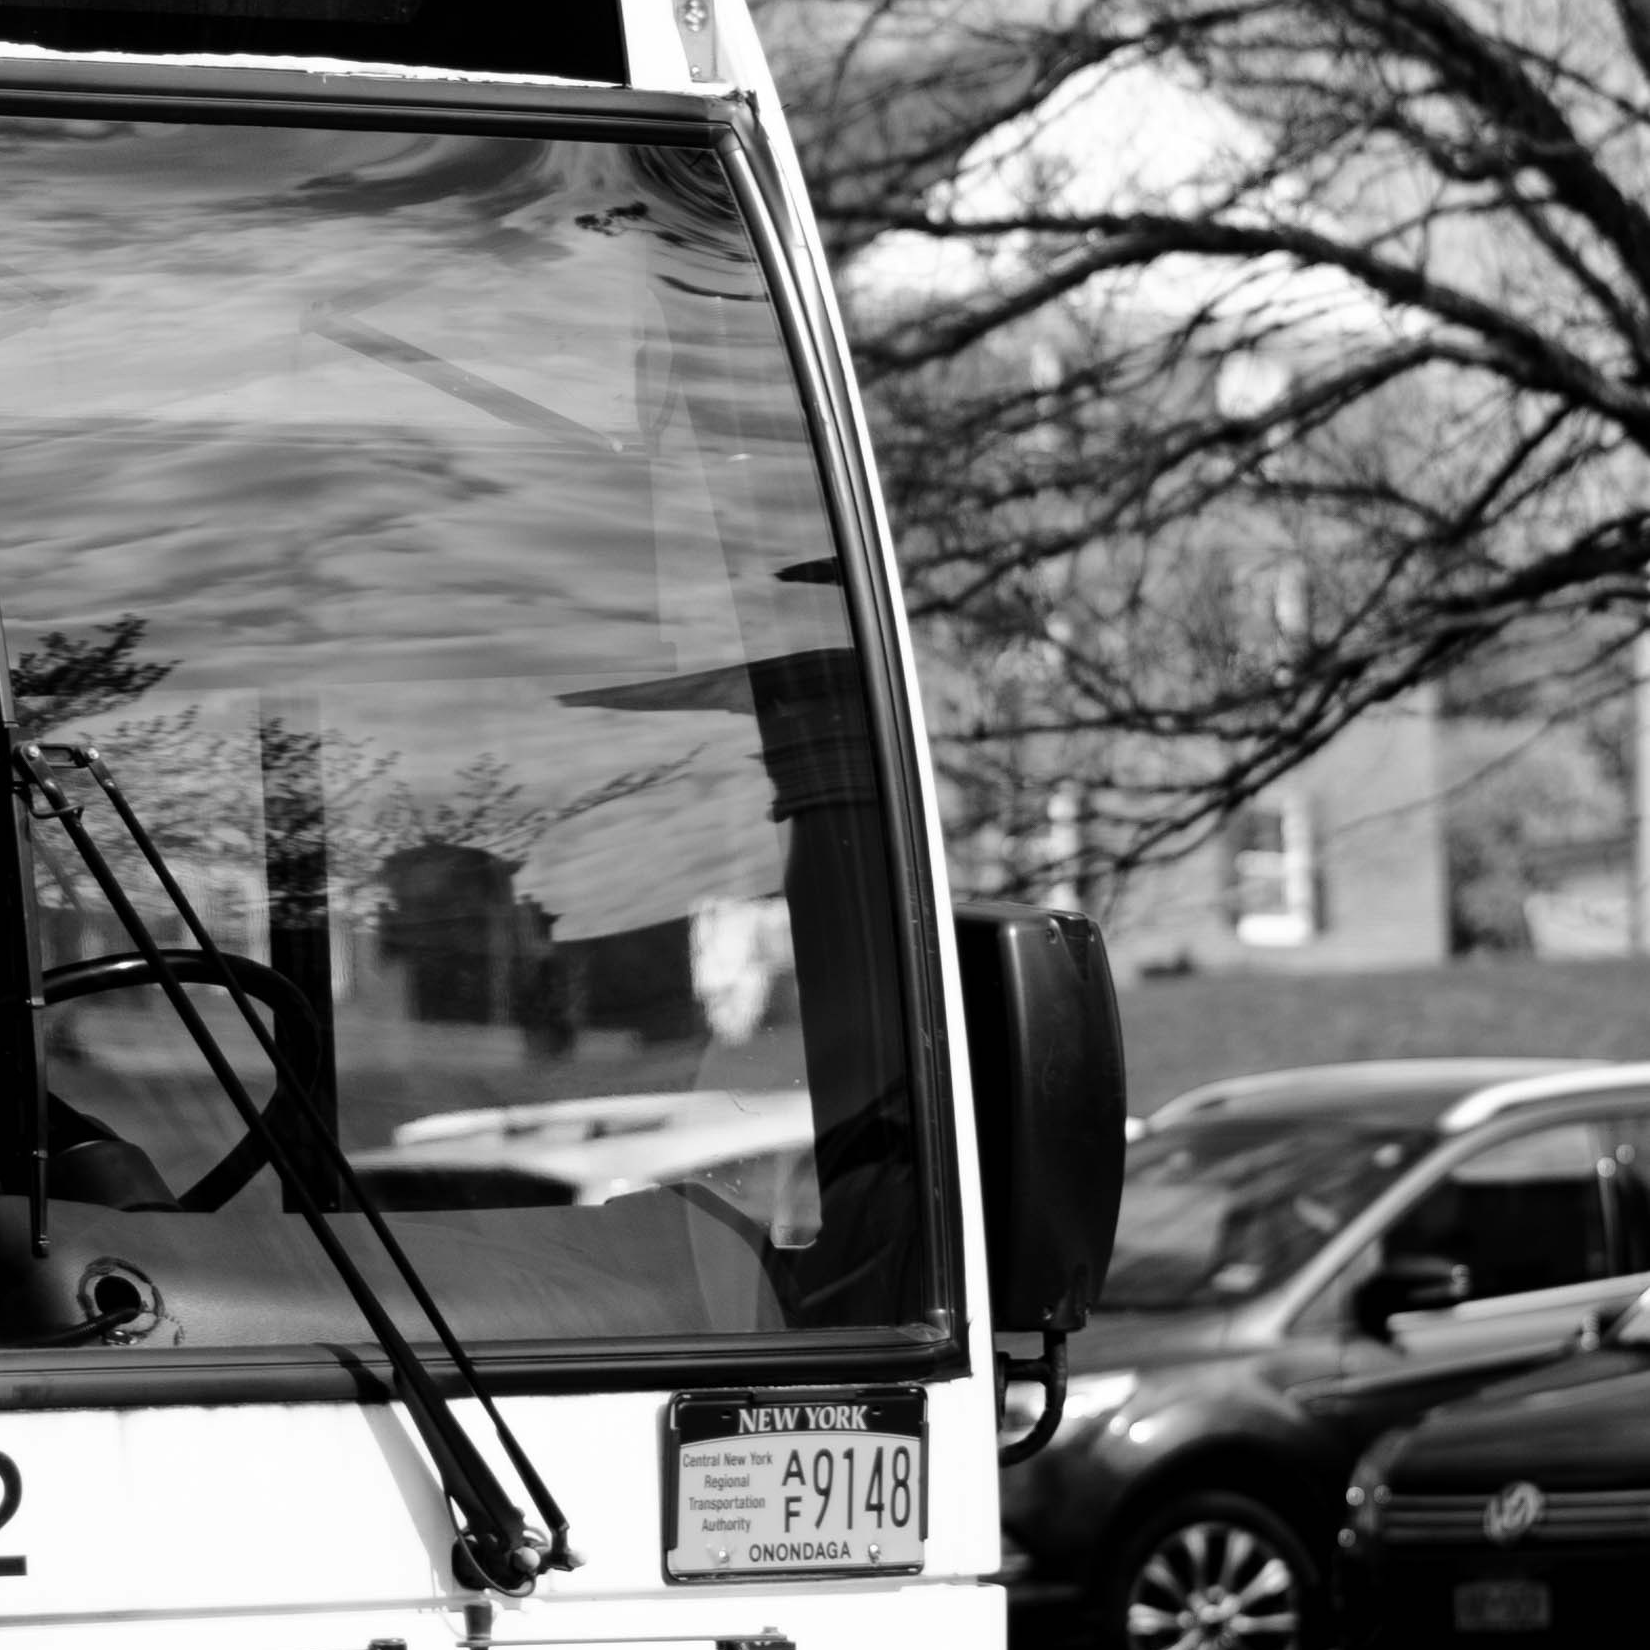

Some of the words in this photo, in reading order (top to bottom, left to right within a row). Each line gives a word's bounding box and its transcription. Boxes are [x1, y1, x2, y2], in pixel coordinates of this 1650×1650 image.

[738, 1407, 800, 1433] NEW
[804, 1405, 868, 1431] YORK
[683, 1452, 720, 1468] Central
[723, 1453, 746, 1467] New
[749, 1450, 773, 1465] York
[704, 1473, 750, 1491] Regional
[812, 1445, 911, 1530] 9148
[688, 1495, 766, 1512] Transportation
[701, 1517, 752, 1533] Authority
[749, 1541, 851, 1563] ONONDAGA
